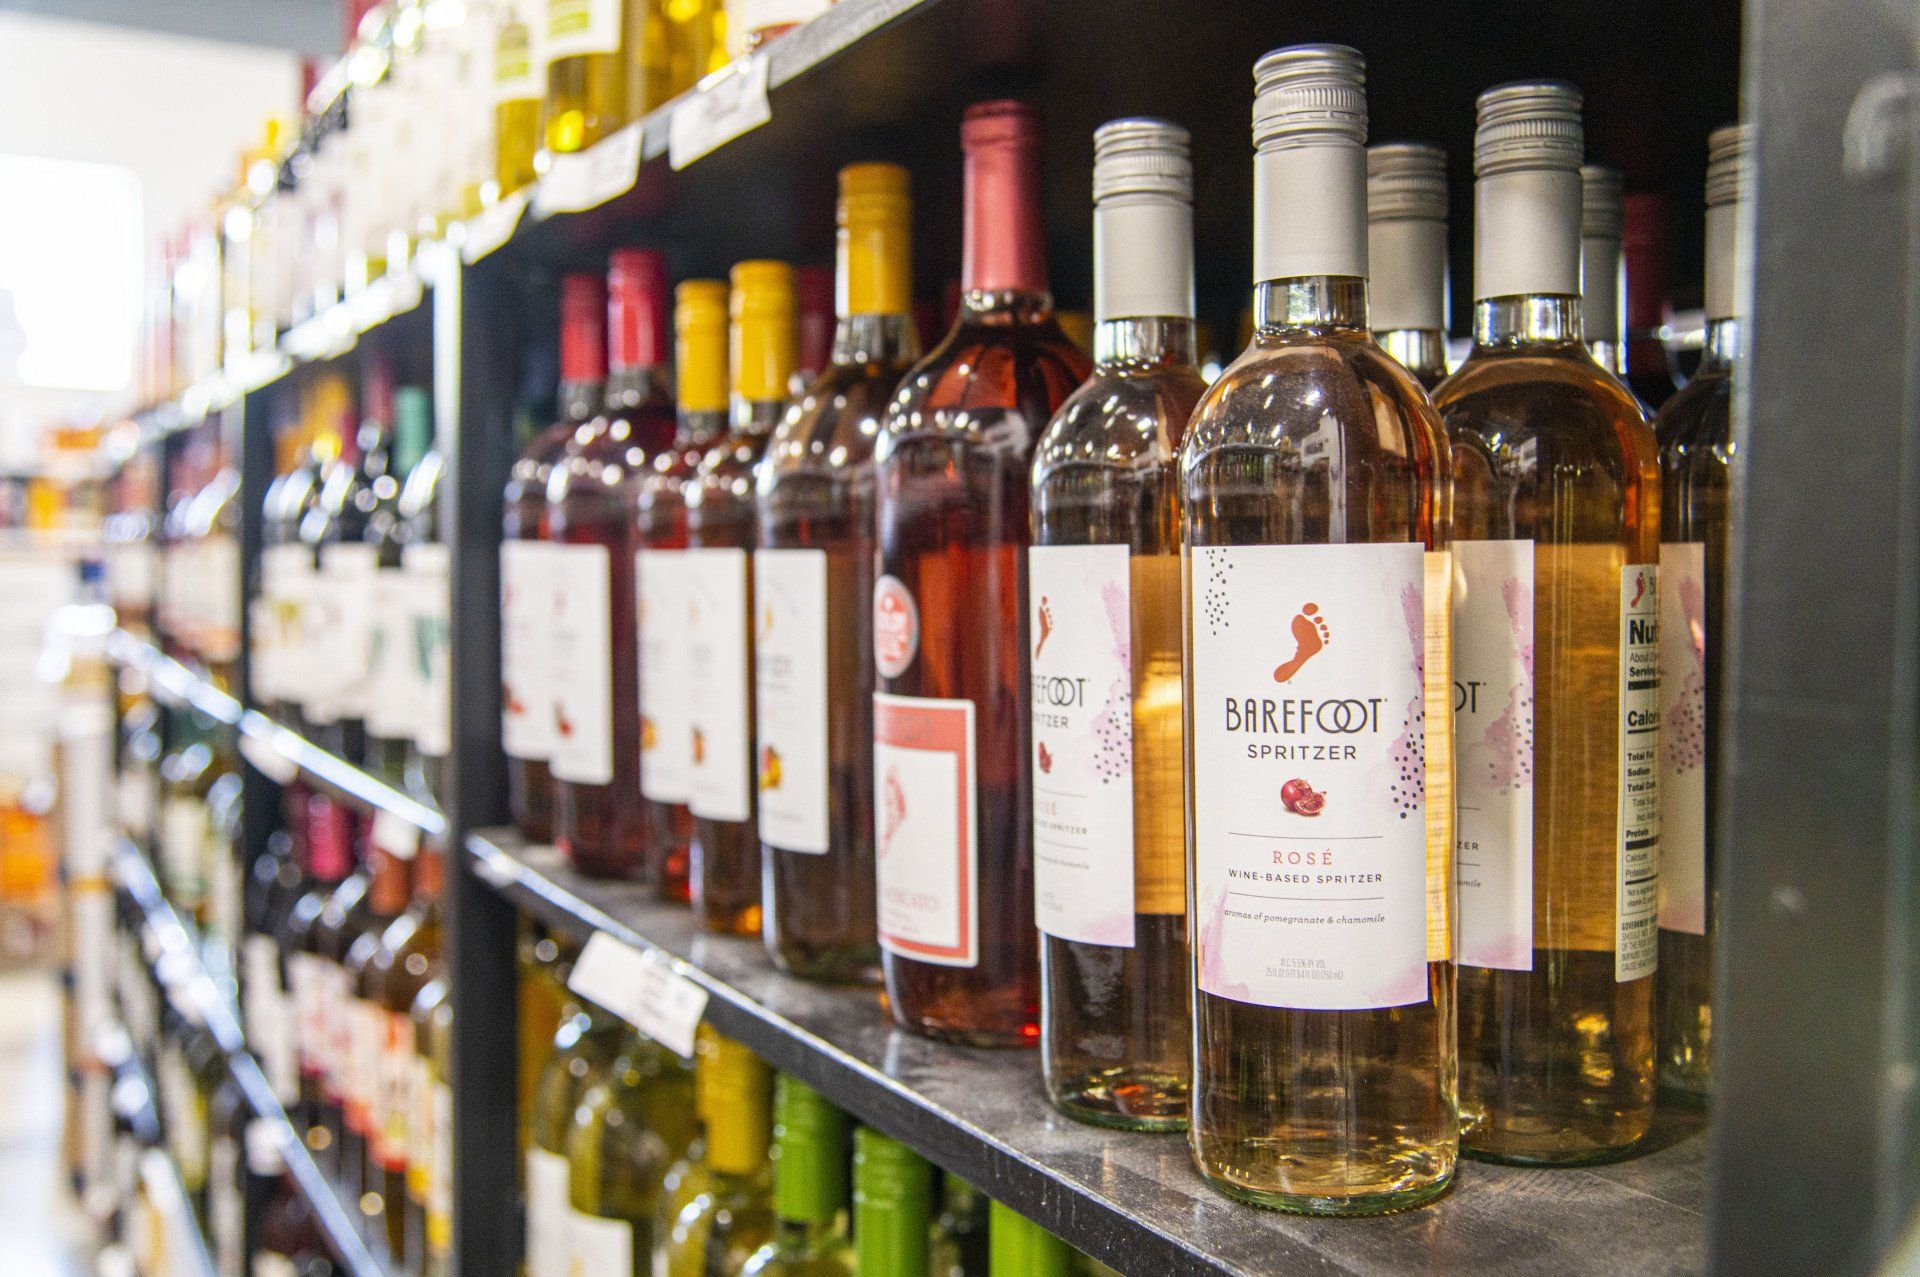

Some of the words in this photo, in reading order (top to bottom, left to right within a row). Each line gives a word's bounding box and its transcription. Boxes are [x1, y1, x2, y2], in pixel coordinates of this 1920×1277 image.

[1226, 697, 1382, 734] BAREFOOT
[1247, 744, 1357, 760] SPRITZER
[1272, 849, 1332, 866] ROSÉ
[1229, 868, 1310, 883] WINE-BASED
[1317, 873, 1382, 884] SPRITZER
[1224, 909, 1252, 920] aromas
[1253, 911, 1263, 920] of
[1263, 914, 1325, 925] pomegranate
[1327, 916, 1334, 924] &
[1336, 914, 1386, 924] chamomile
